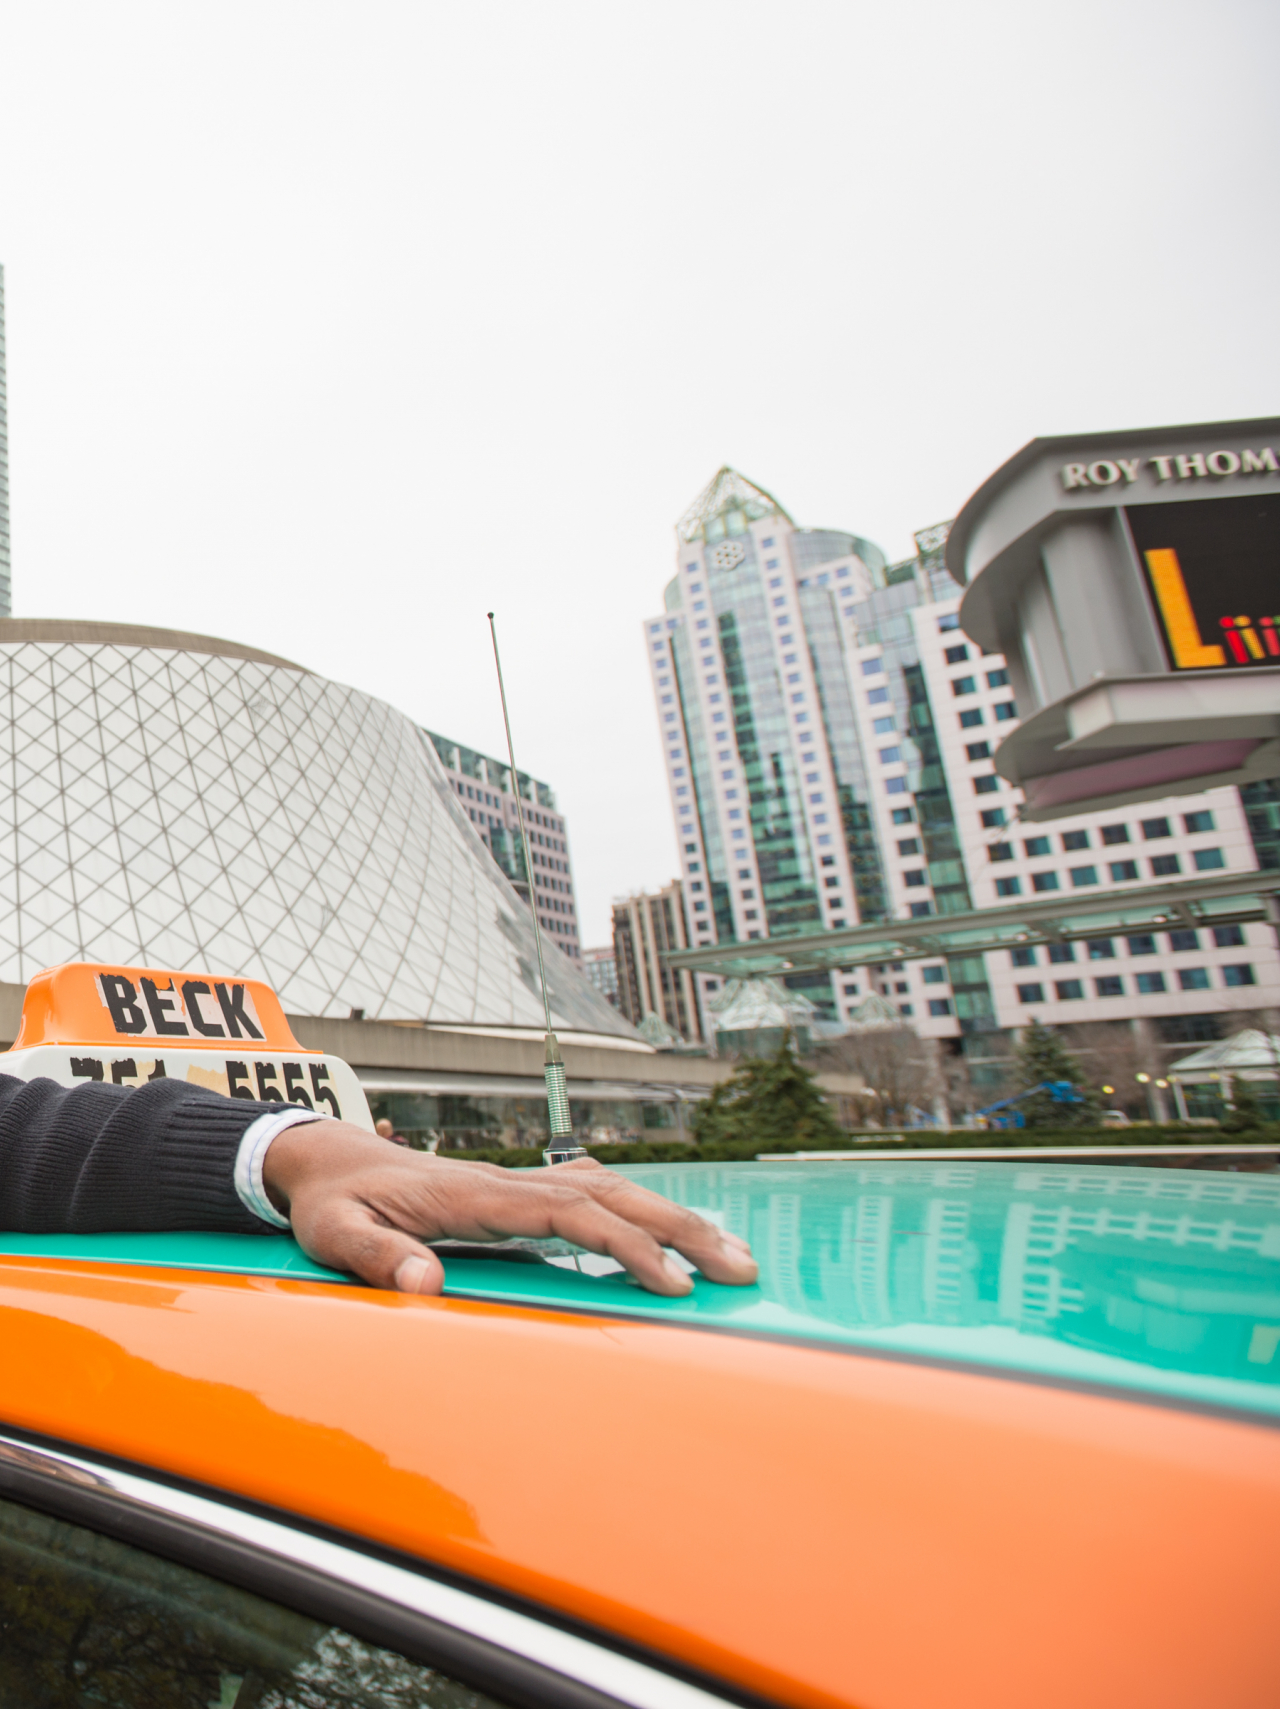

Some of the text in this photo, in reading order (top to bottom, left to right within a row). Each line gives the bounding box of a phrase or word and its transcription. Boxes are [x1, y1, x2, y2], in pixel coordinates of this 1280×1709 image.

[1063, 447, 1280, 489] ROY THOM
[99, 973, 265, 1040] BECK
